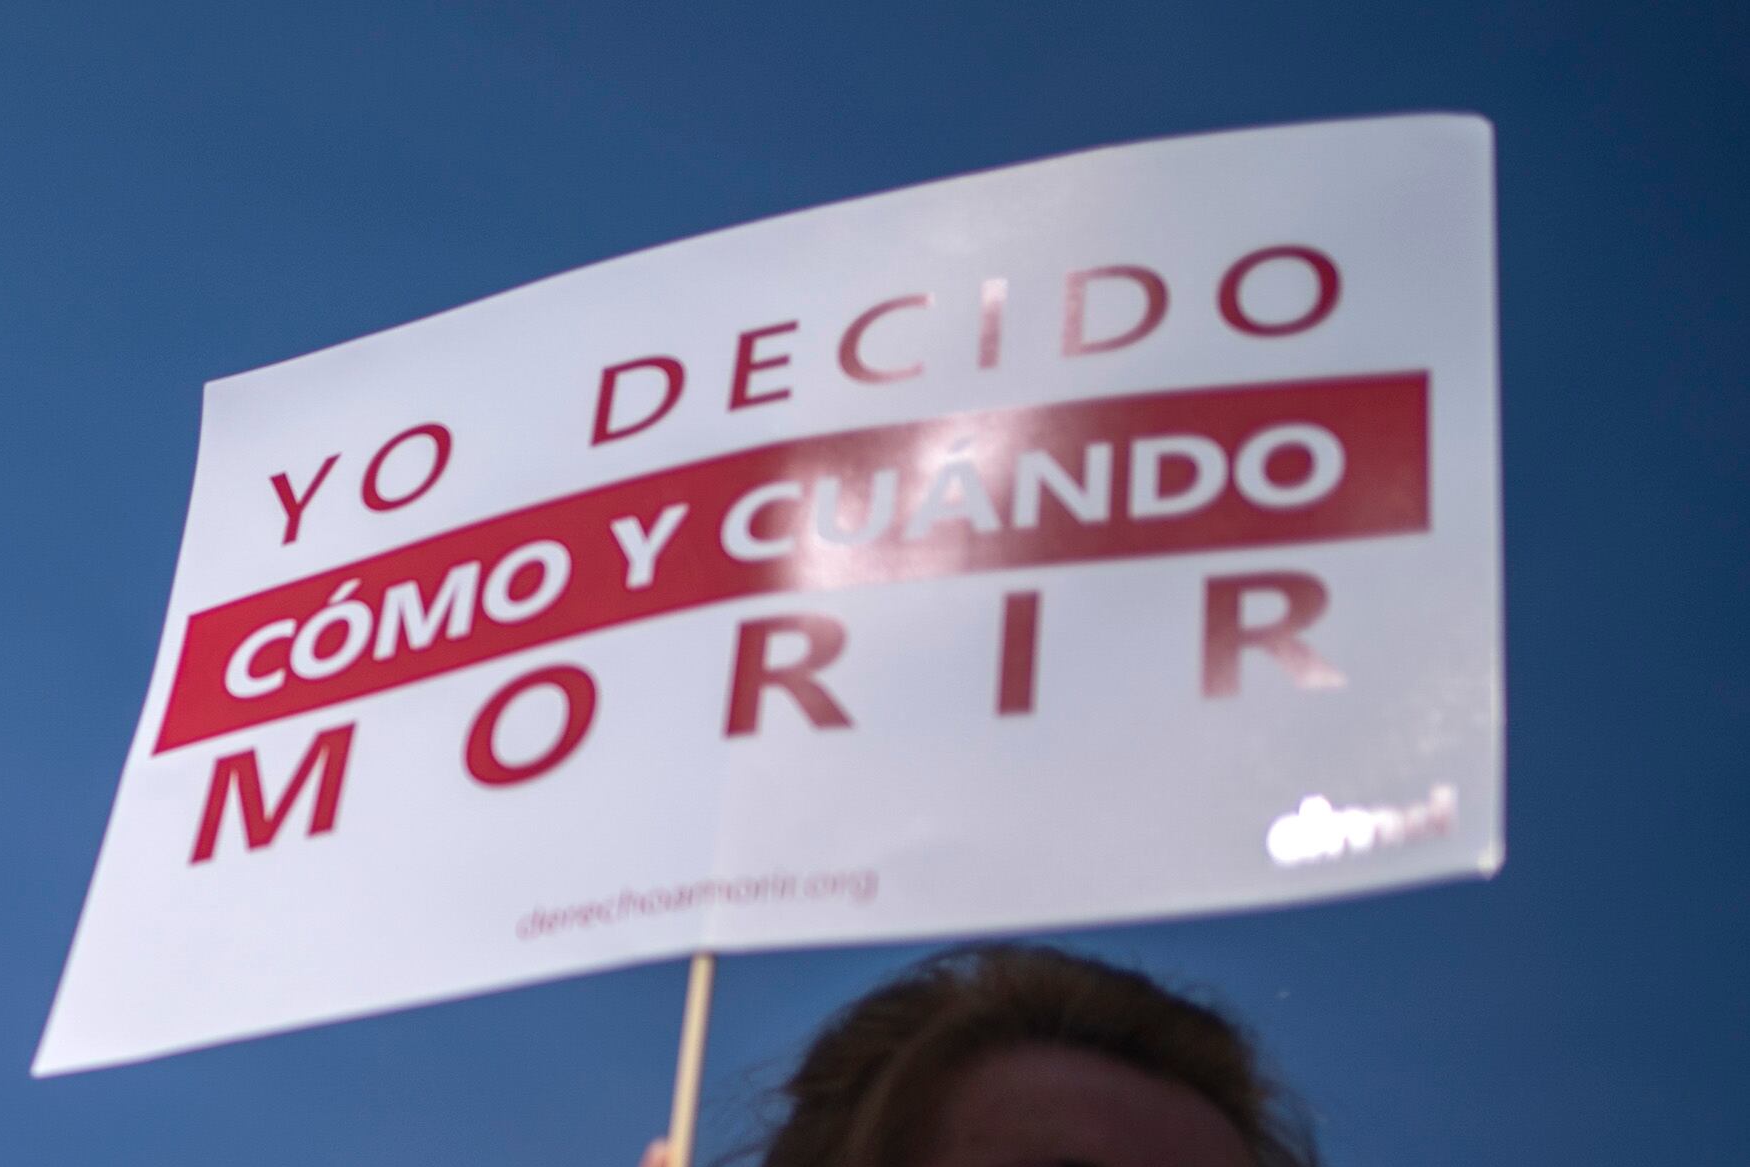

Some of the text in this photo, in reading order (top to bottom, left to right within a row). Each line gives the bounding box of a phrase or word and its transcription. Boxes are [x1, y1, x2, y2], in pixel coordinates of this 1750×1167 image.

[268, 244, 1341, 546] YO DECIDO
[223, 422, 1346, 699] CÓMO Y CUÁNDO
[187, 570, 1346, 865] MORIR
